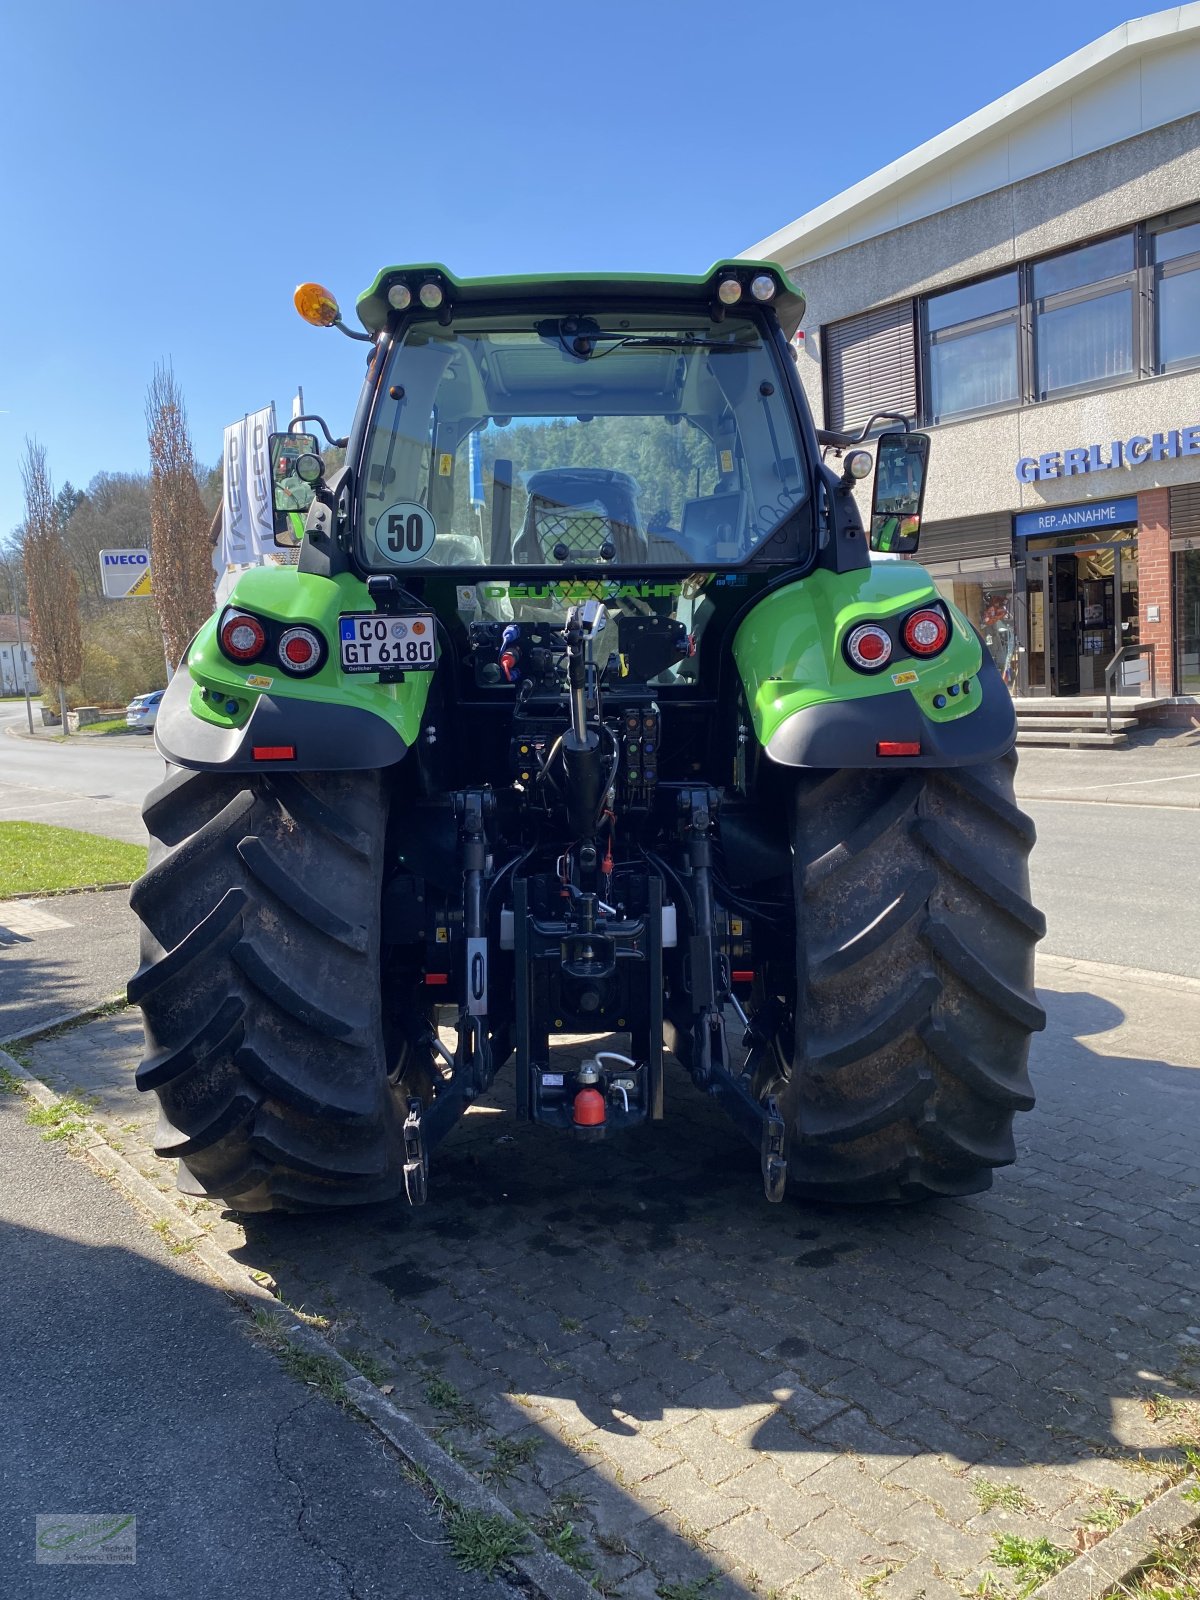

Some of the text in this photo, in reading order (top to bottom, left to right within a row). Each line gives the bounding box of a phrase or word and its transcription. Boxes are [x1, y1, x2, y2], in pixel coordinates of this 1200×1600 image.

[1038, 506, 1116, 528] REP.-ANNAHME
[387, 513, 423, 552] 50
[104, 554, 147, 565] IVECO
[359, 620, 388, 641] CO
[345, 641, 433, 664] GT 6180
